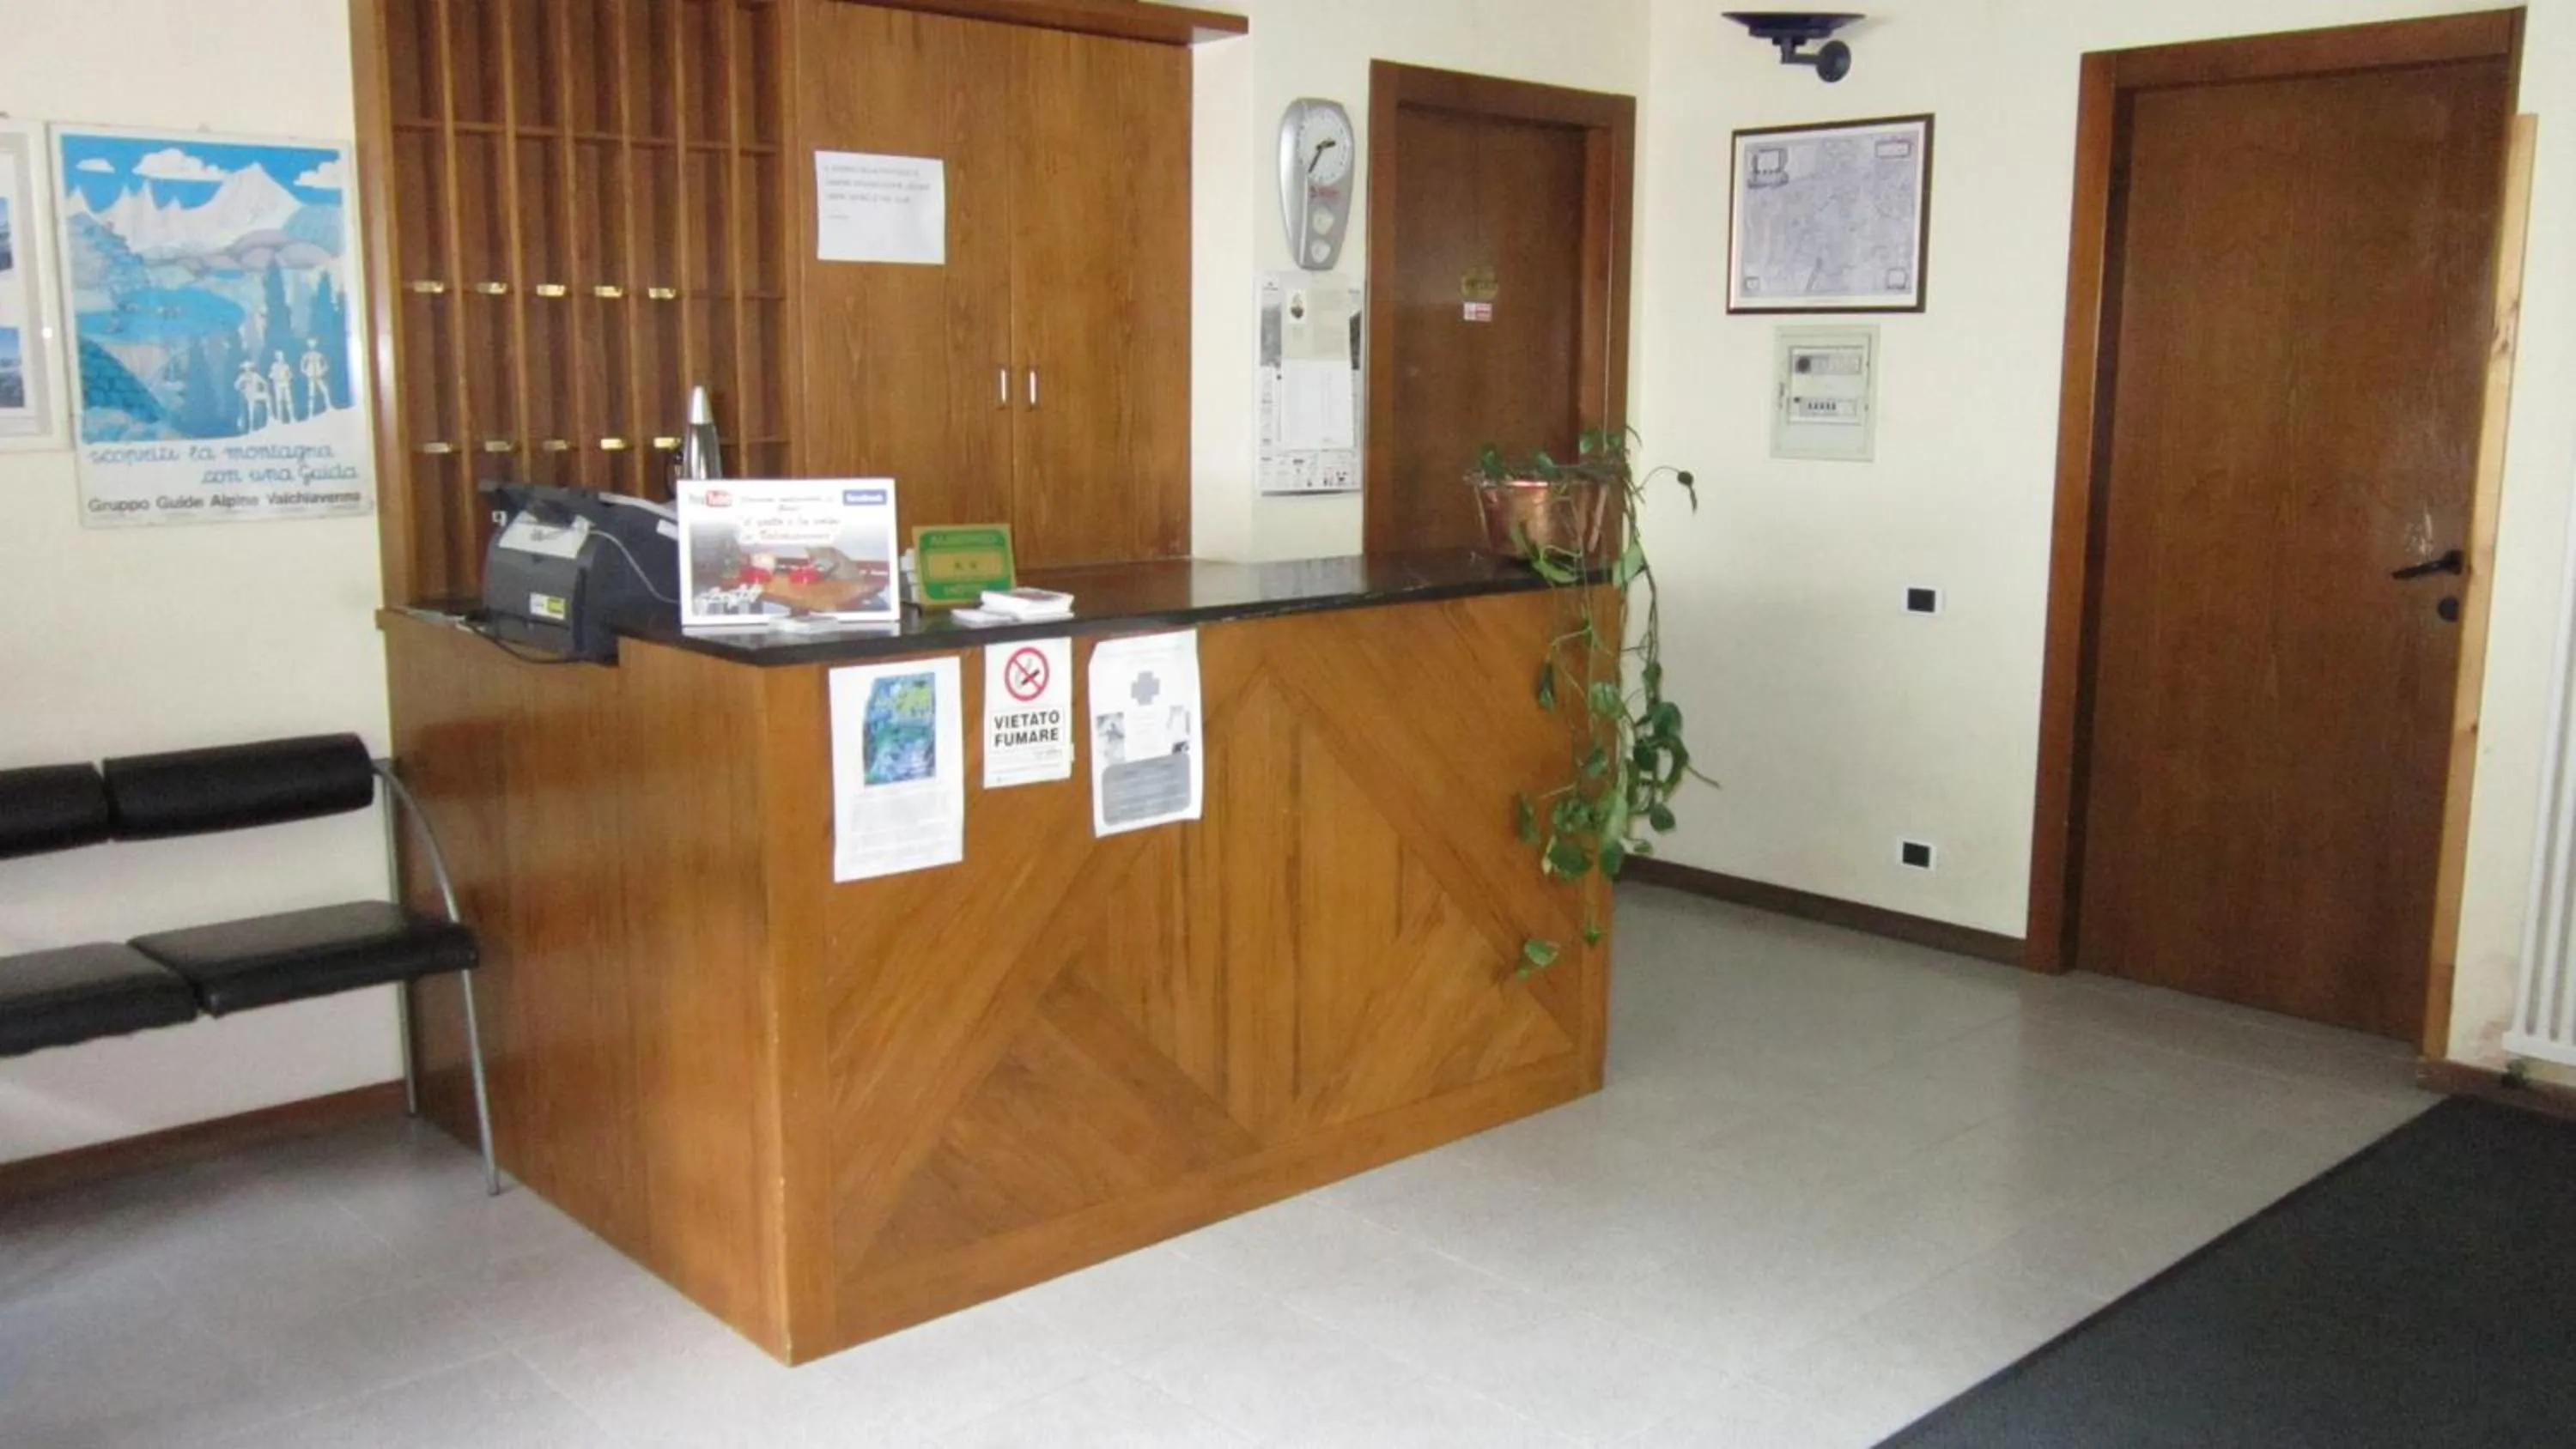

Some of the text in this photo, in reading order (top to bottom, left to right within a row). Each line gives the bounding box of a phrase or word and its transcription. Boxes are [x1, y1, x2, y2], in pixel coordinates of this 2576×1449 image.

[224, 442, 334, 462] montagna
[201, 469, 242, 486] con
[88, 496, 149, 513] Gruppo
[156, 494, 204, 510] Guide
[210, 490, 259, 508] Alpine
[993, 709, 1060, 730] VIETATO
[994, 727, 1059, 748] FUMARE
